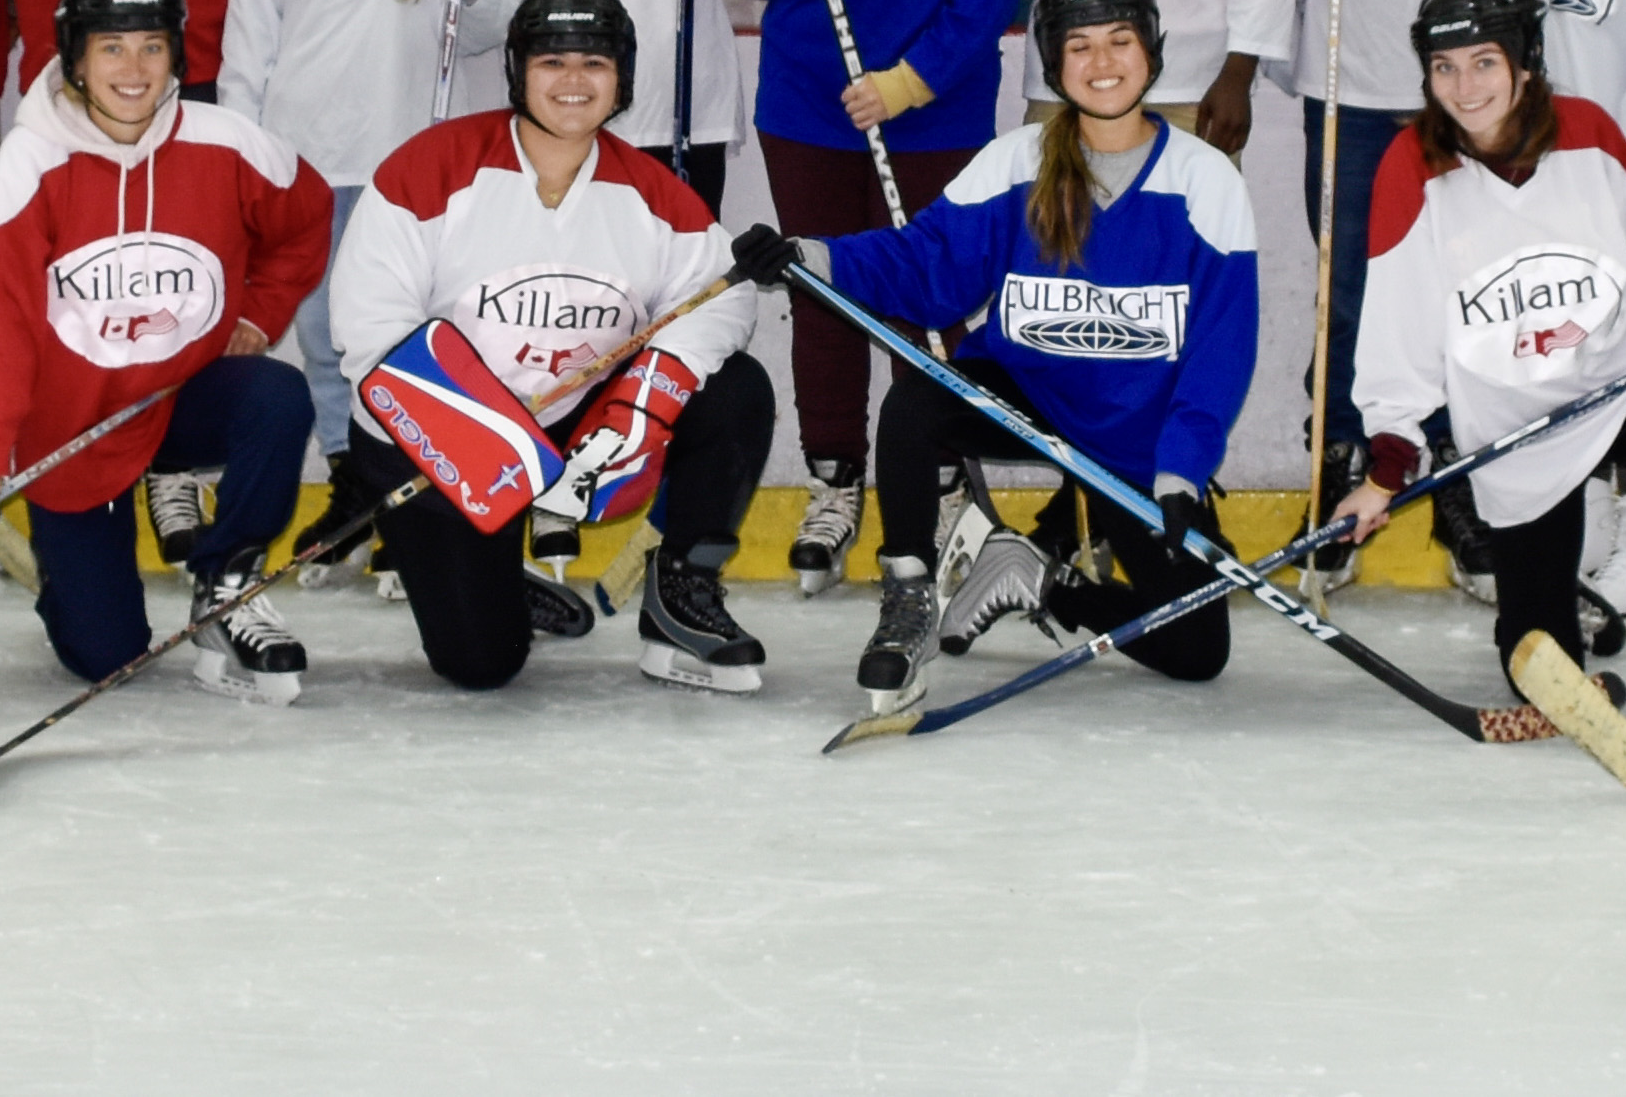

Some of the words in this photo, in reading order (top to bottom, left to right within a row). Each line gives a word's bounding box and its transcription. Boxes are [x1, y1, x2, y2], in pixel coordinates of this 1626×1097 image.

[55, 263, 195, 301] Killam
[477, 284, 621, 330] Killam
[1457, 271, 1600, 326] Killam
[1006, 278, 1188, 361] FULBRIGHT
[1215, 557, 1341, 641] CCM
